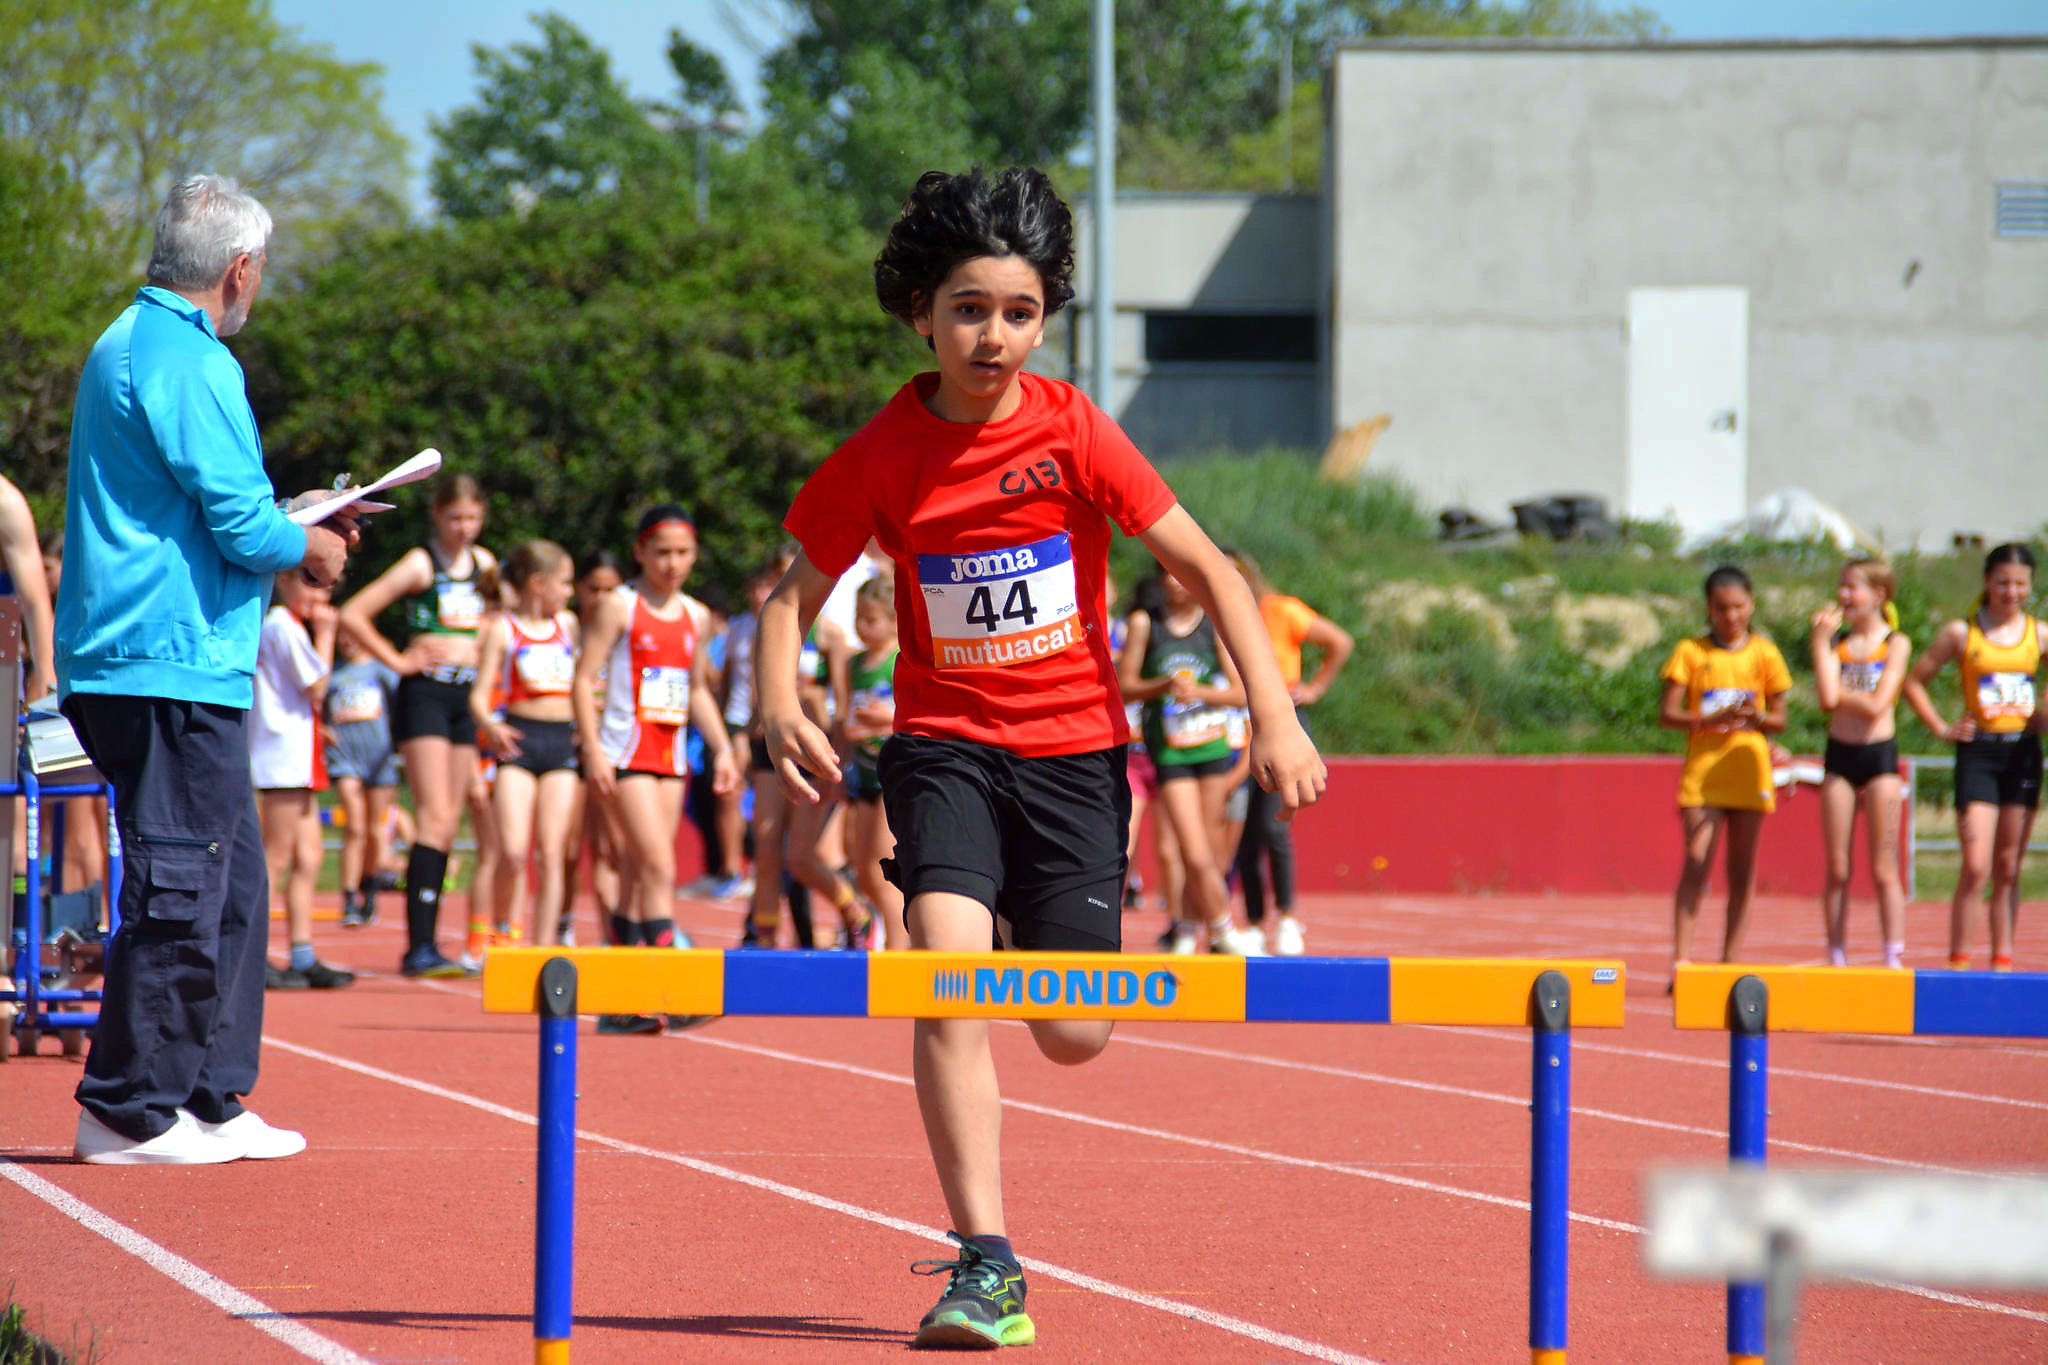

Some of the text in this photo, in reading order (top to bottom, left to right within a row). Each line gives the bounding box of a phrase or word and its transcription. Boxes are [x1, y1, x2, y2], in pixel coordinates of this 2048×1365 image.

[951, 548, 1038, 582] Joma
[966, 580, 1038, 633] 44
[943, 621, 1074, 665] mutuacat
[974, 967, 1178, 1007] MONDO
